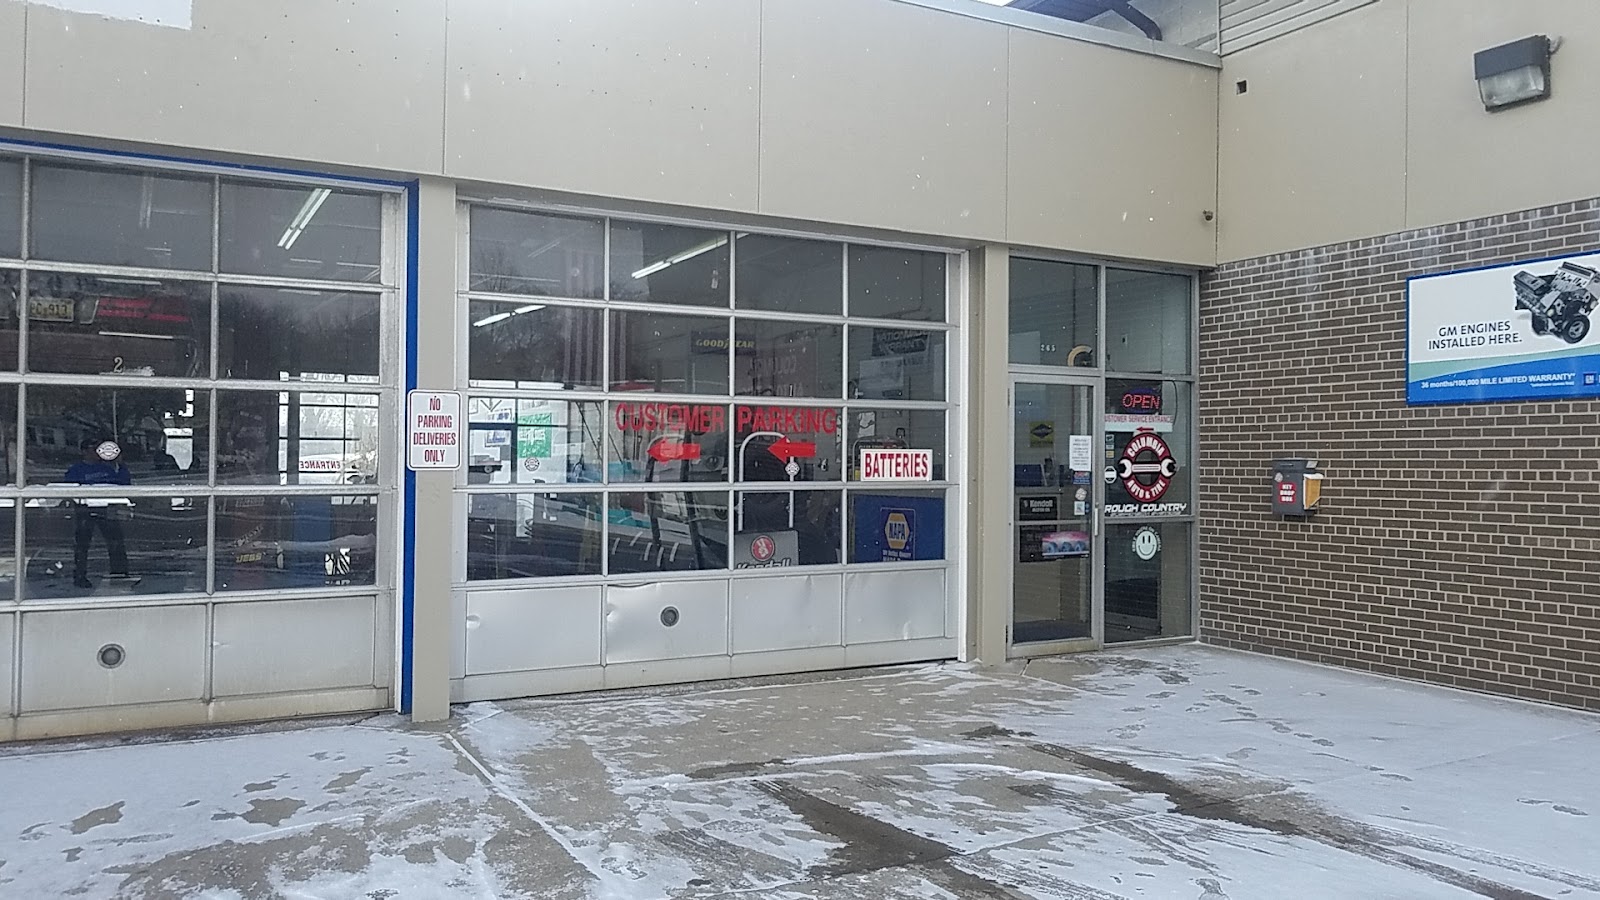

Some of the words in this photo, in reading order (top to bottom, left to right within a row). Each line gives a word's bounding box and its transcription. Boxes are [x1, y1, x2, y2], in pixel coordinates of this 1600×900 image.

[1438, 326, 1457, 337] GM
[1461, 320, 1511, 335] ENGINES
[695, 338, 755, 349] GOODEAR
[1040, 344, 1056, 352] 265
[1428, 335, 1486, 350] INSTALLED
[1488, 332, 1523, 345] HERE.
[113, 356, 124, 373] 2
[1480, 377, 1498, 385] MILE
[1498, 375, 1527, 384] LIMITED
[429, 397, 441, 411] NO
[1122, 393, 1160, 409] OPEN
[417, 415, 453, 428] PARKING
[615, 402, 725, 433] CUSTOMER
[737, 406, 837, 434] PARKING
[1128, 414, 1147, 423] SERVICE
[413, 432, 457, 446] DELIVERIES
[1127, 436, 1166, 458] COLUMBIA
[424, 449, 446, 463] ONLY
[864, 453, 929, 478] BATTERIES
[1126, 479, 1144, 499] AUTO
[1145, 490, 1151, 499] &
[1150, 479, 1166, 497] TIRE
[1104, 503, 1139, 513] ROUGH
[1141, 502, 1187, 512] COUNTRY
[888, 522, 906, 540] NAPA
